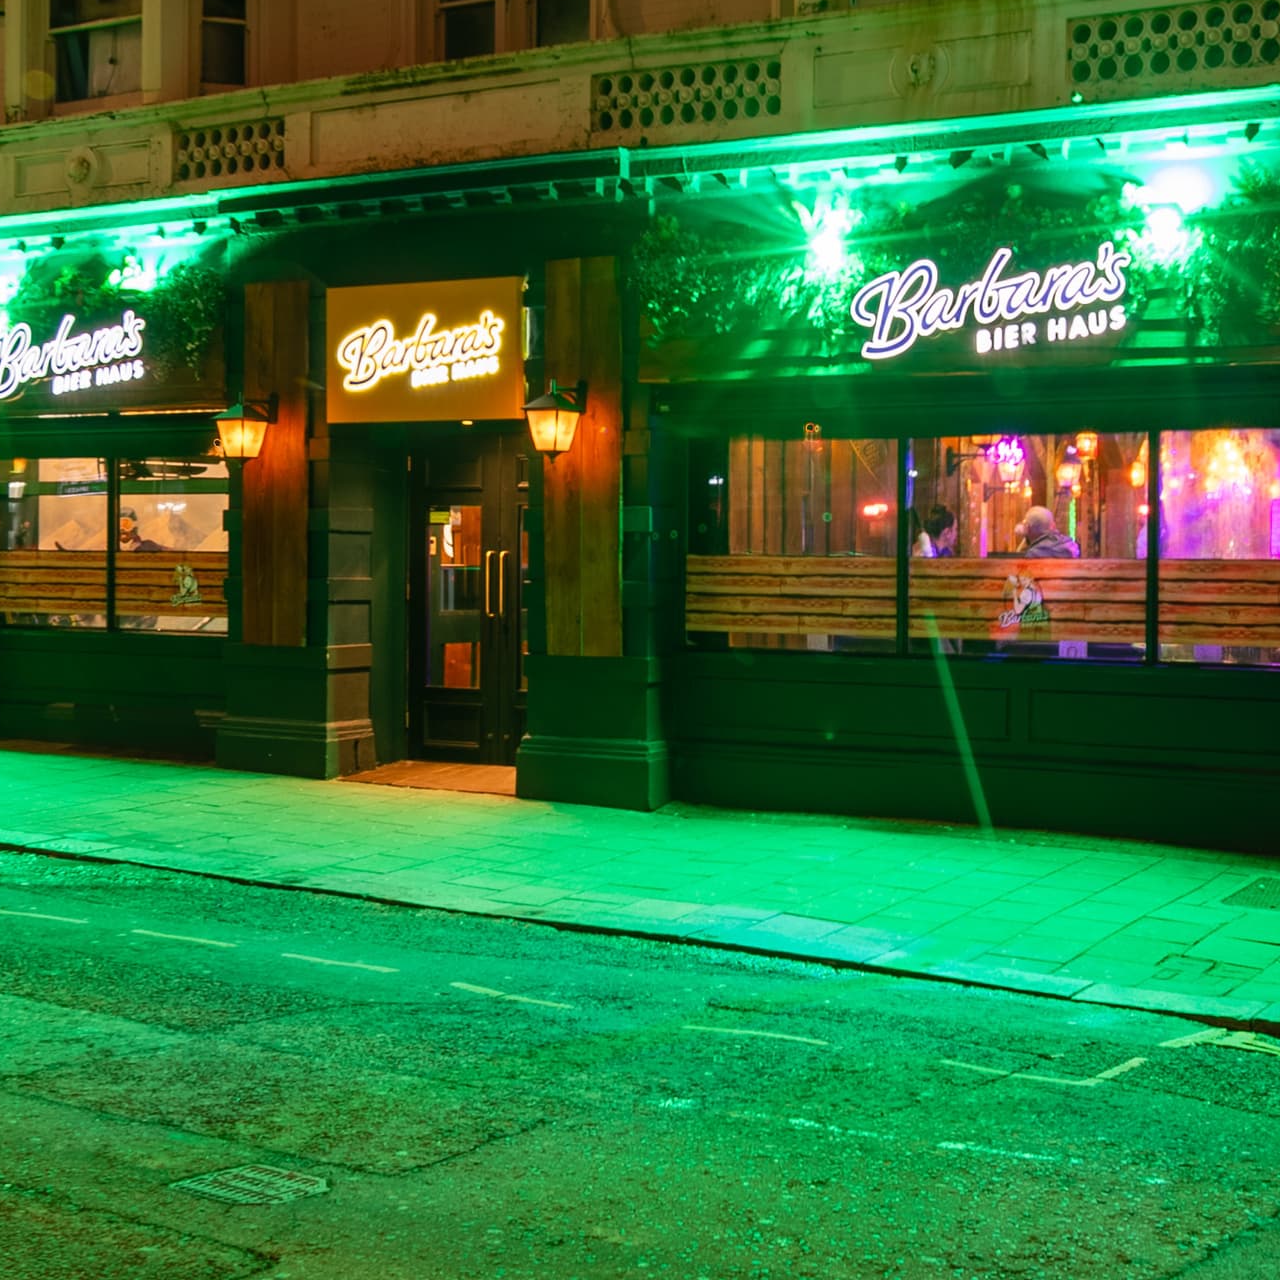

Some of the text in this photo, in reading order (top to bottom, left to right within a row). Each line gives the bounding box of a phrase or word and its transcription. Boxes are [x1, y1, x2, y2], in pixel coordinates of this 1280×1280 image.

[850, 241, 1132, 359] Barbara's
[975, 305, 1128, 354] BIER HAUS
[52, 360, 145, 396] BIER HAUS
[337, 309, 505, 393] Barbara's
